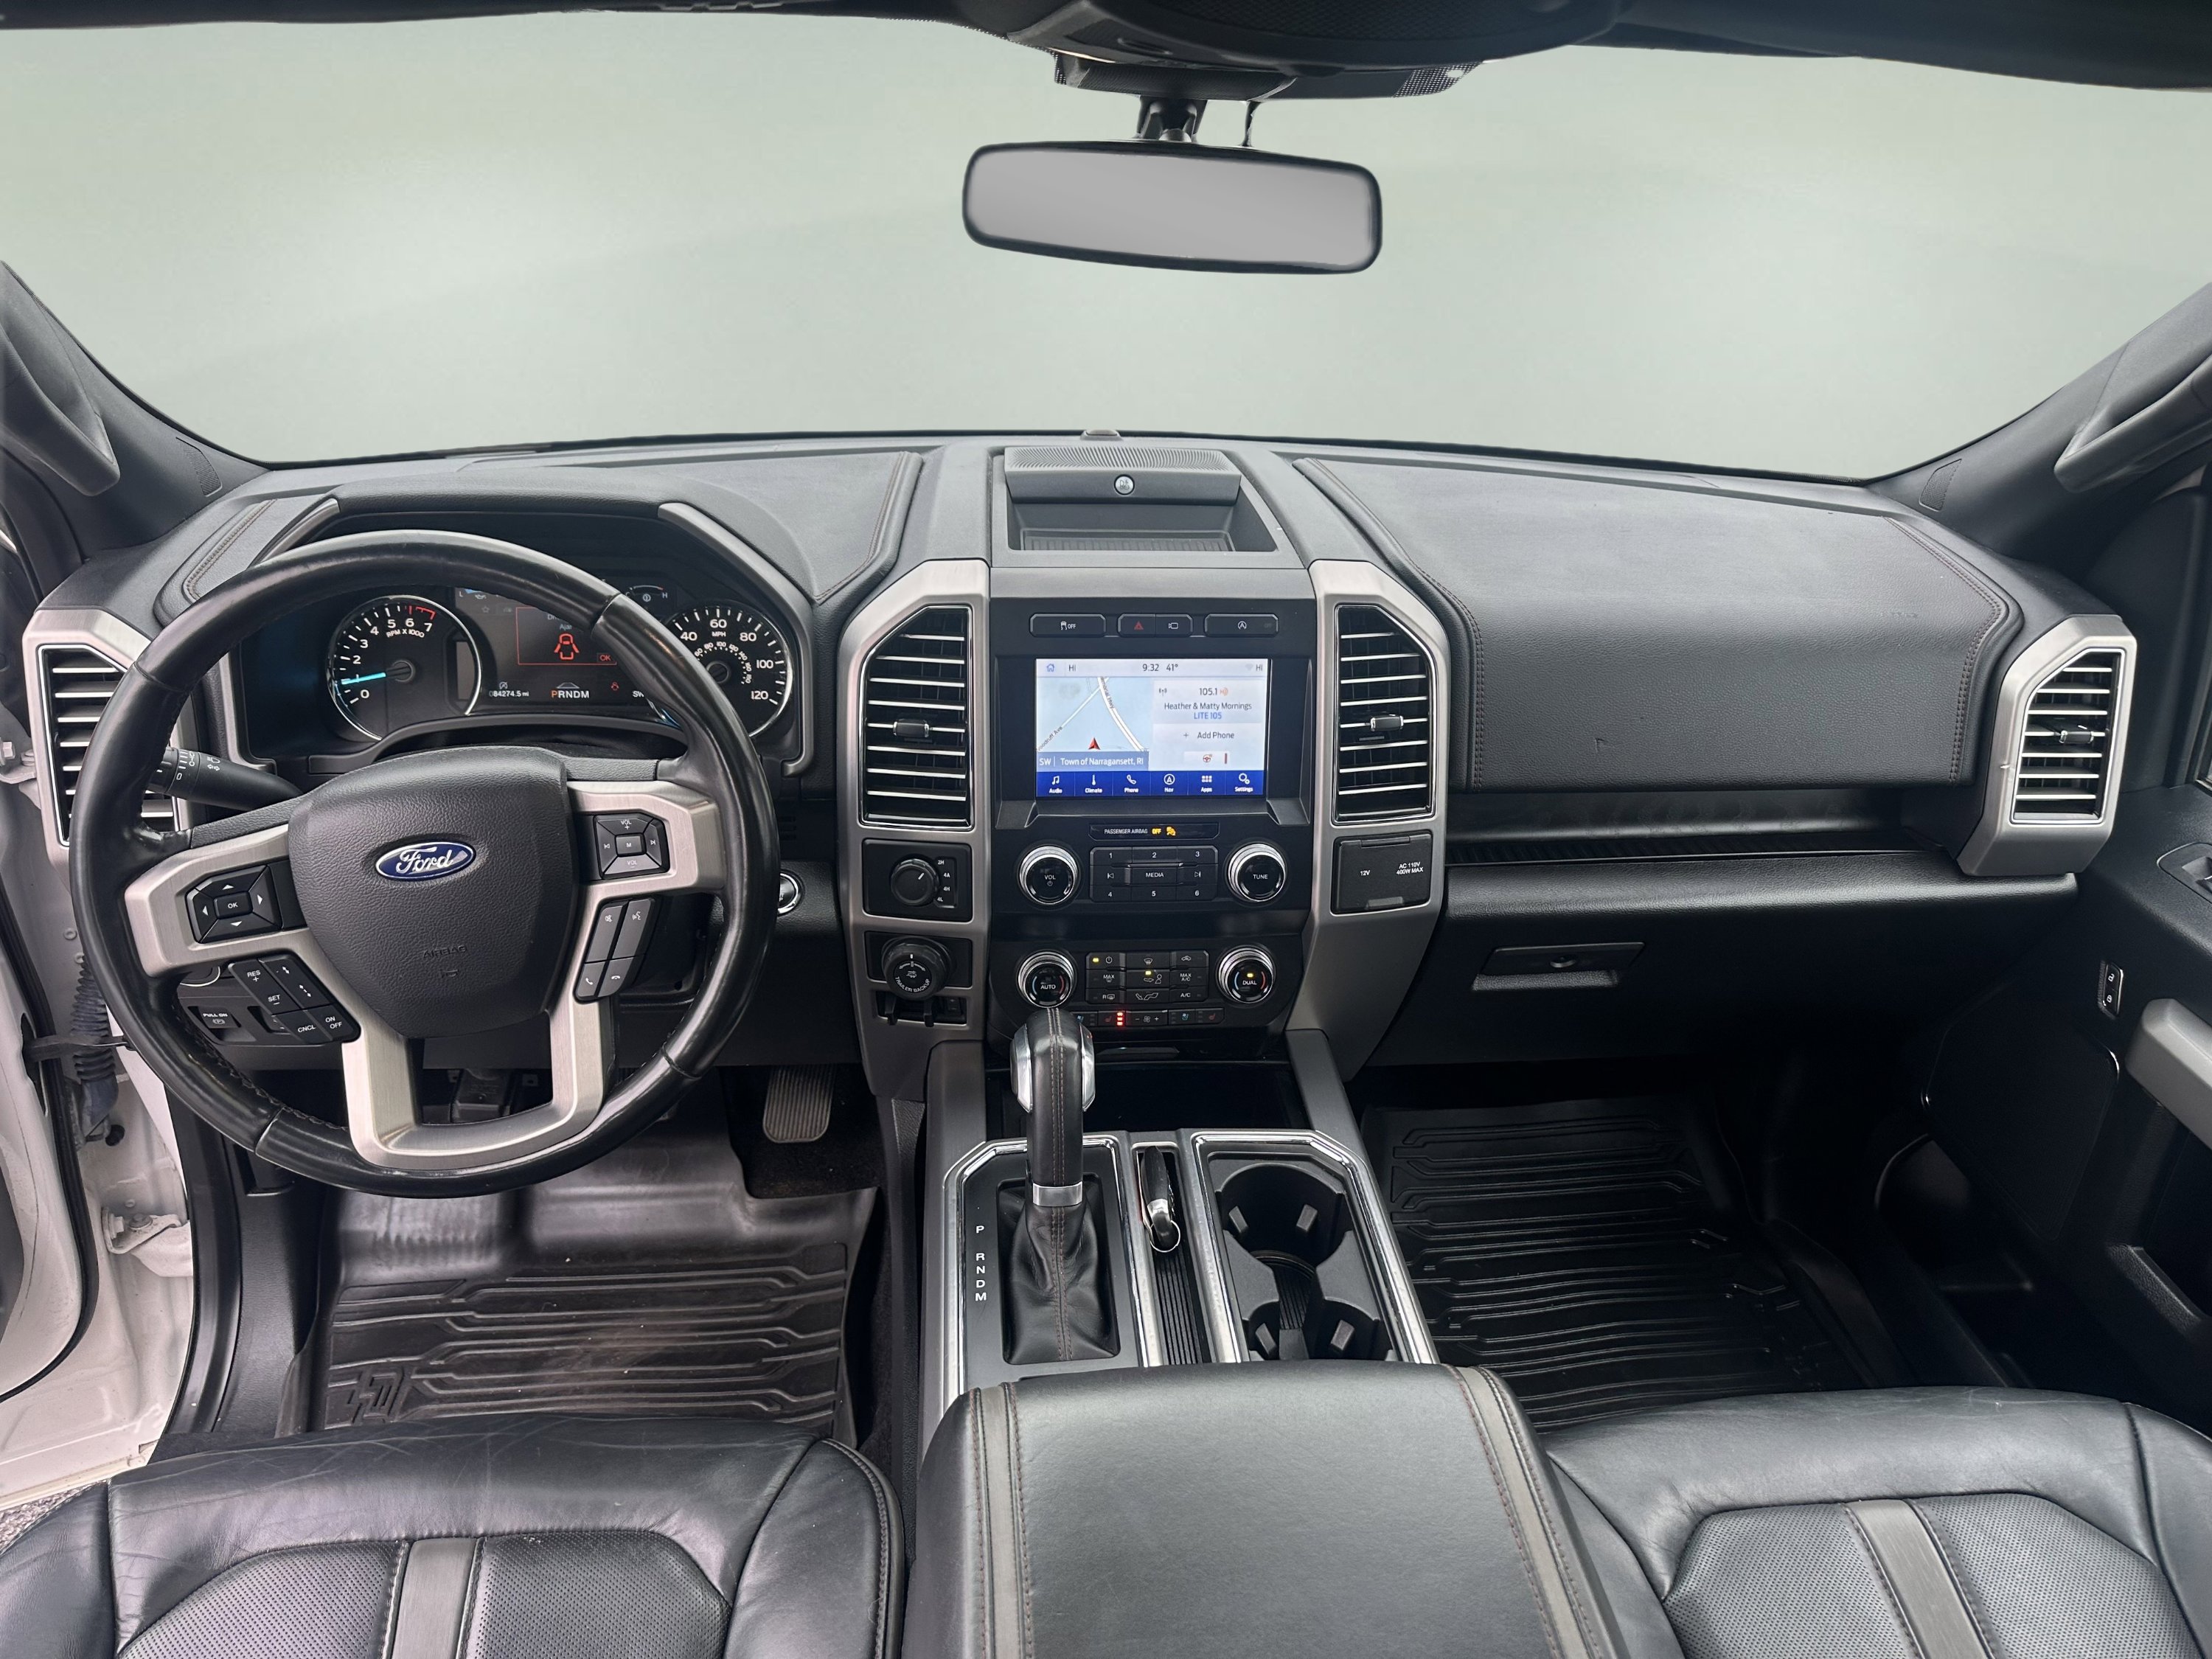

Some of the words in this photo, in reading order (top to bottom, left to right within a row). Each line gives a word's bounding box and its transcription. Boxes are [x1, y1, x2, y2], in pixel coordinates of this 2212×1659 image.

[387, 619, 397, 628] 5
[406, 618, 414, 627] 6
[424, 622, 433, 632] 7
[709, 619, 727, 628] 60
[370, 627, 379, 636] 4
[386, 630, 401, 638] RPM
[680, 631, 698, 641] 40
[740, 632, 757, 641] 80
[360, 639, 369, 649] 3
[352, 655, 361, 664] 2
[756, 659, 773, 669] 100
[1142, 664, 1159, 672] 9:32
[361, 689, 369, 698] 0
[552, 690, 589, 699] PRNDM
[751, 690, 769, 700] 120
[1199, 687, 1218, 696] 105.1
[1200, 703, 1220, 711] Matty
[1221, 703, 1252, 711] Mornings
[1194, 712, 1209, 720] LITE
[1210, 712, 1222, 720] 105
[1039, 758, 1051, 766] SW
[1080, 757, 1088, 765] of
[395, 846, 455, 873] Ford
[246, 970, 261, 978] RES
[894, 976, 913, 993] TRAILER
[913, 978, 931, 993] BACKUP
[268, 994, 281, 1002] SET
[297, 1024, 316, 1033] CNCL
[330, 1021, 343, 1029] OFF
[976, 1225, 984, 1234] P
[976, 1252, 985, 1261] R
[976, 1265, 986, 1274] N
[976, 1279, 985, 1288] D
[975, 1292, 987, 1301] M
